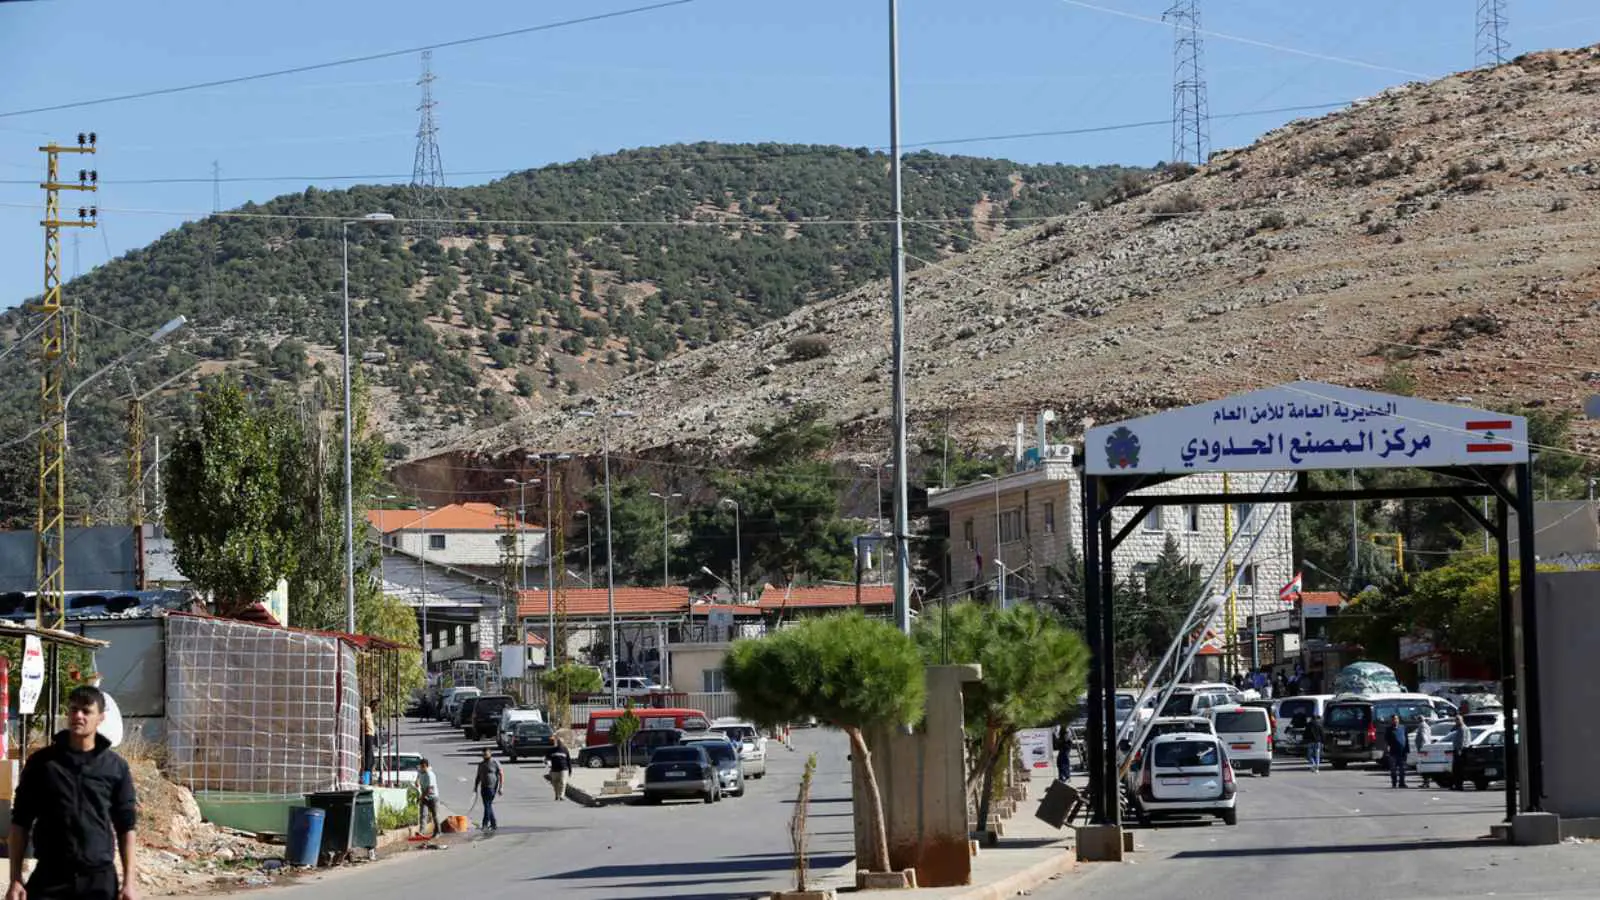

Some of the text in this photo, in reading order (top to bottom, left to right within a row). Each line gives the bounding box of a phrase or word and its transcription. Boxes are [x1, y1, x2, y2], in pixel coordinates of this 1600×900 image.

[1213, 401, 1397, 424] المديرية العامة للأمن العام
[1181, 425, 1431, 467] مركز المصنع الحدودي
